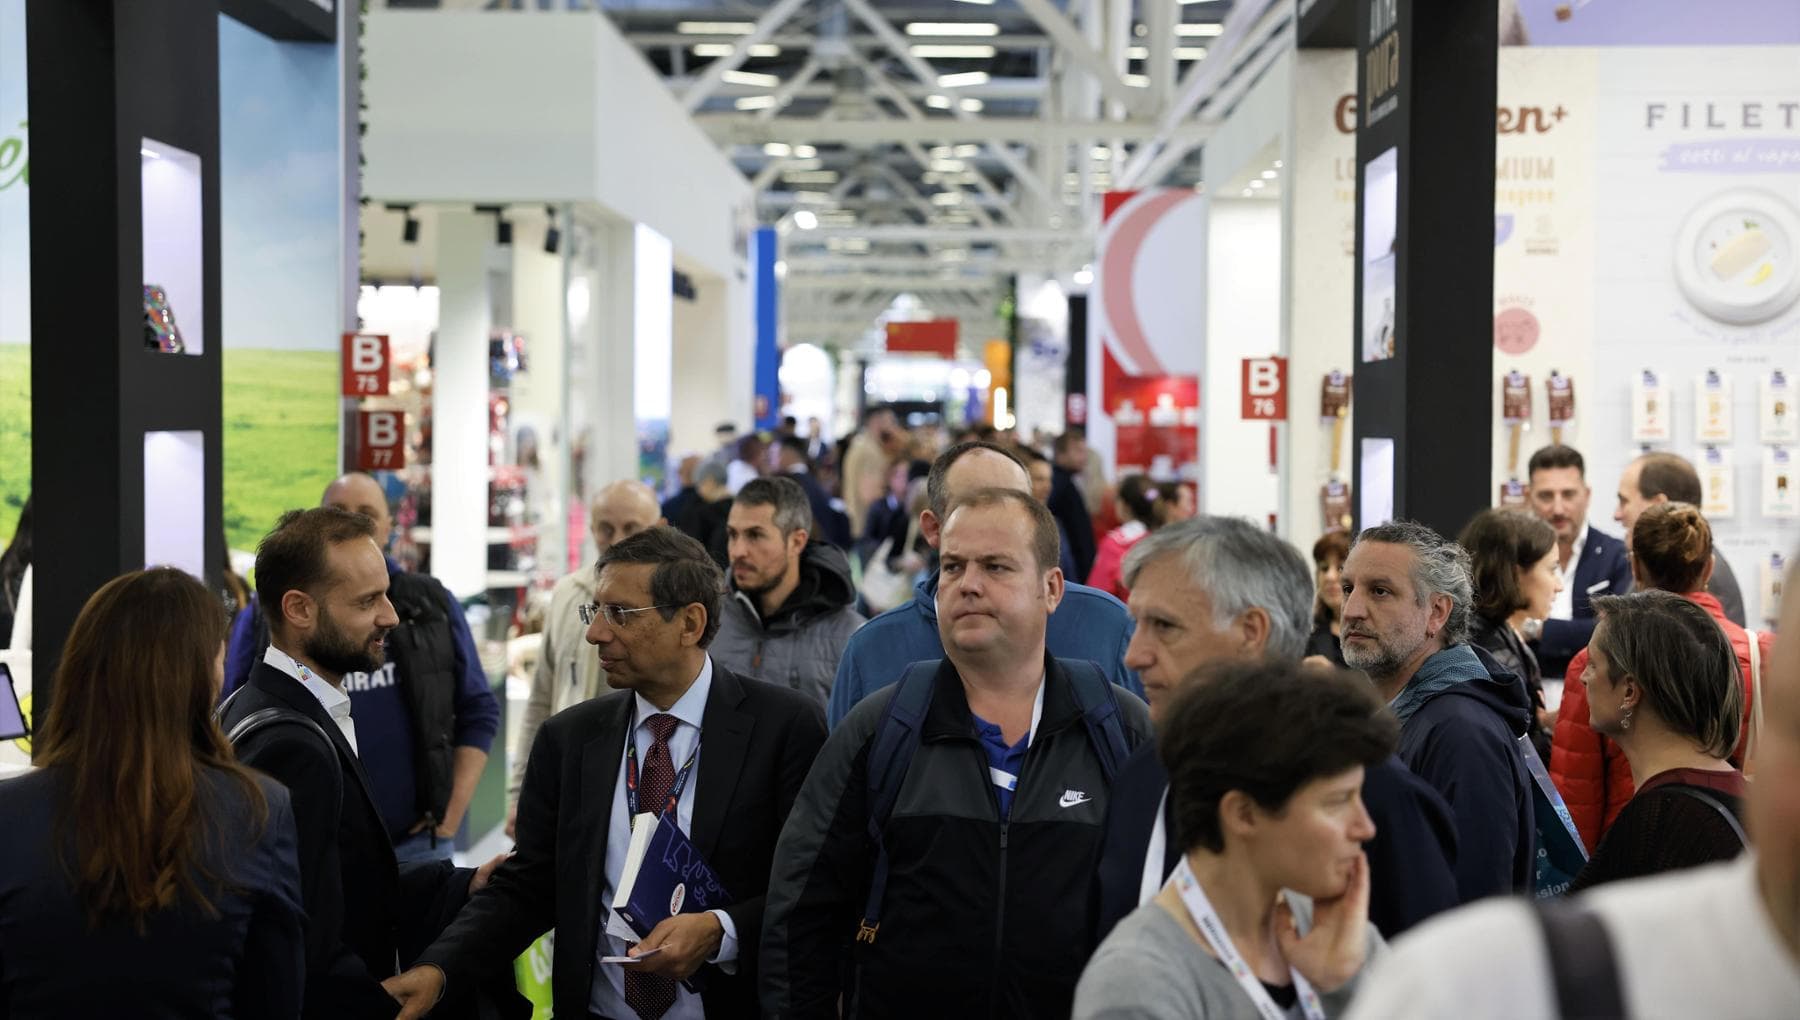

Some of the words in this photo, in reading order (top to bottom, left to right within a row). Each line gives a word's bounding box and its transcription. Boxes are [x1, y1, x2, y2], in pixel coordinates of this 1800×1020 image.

[353, 336, 383, 372] B
[356, 374, 379, 393] 75
[1249, 361, 1280, 395] B
[1252, 398, 1276, 417] 76
[369, 412, 397, 446] B
[372, 449, 393, 465] 77
[343, 662, 396, 692] IRAT
[1063, 789, 1085, 801] NIKE
